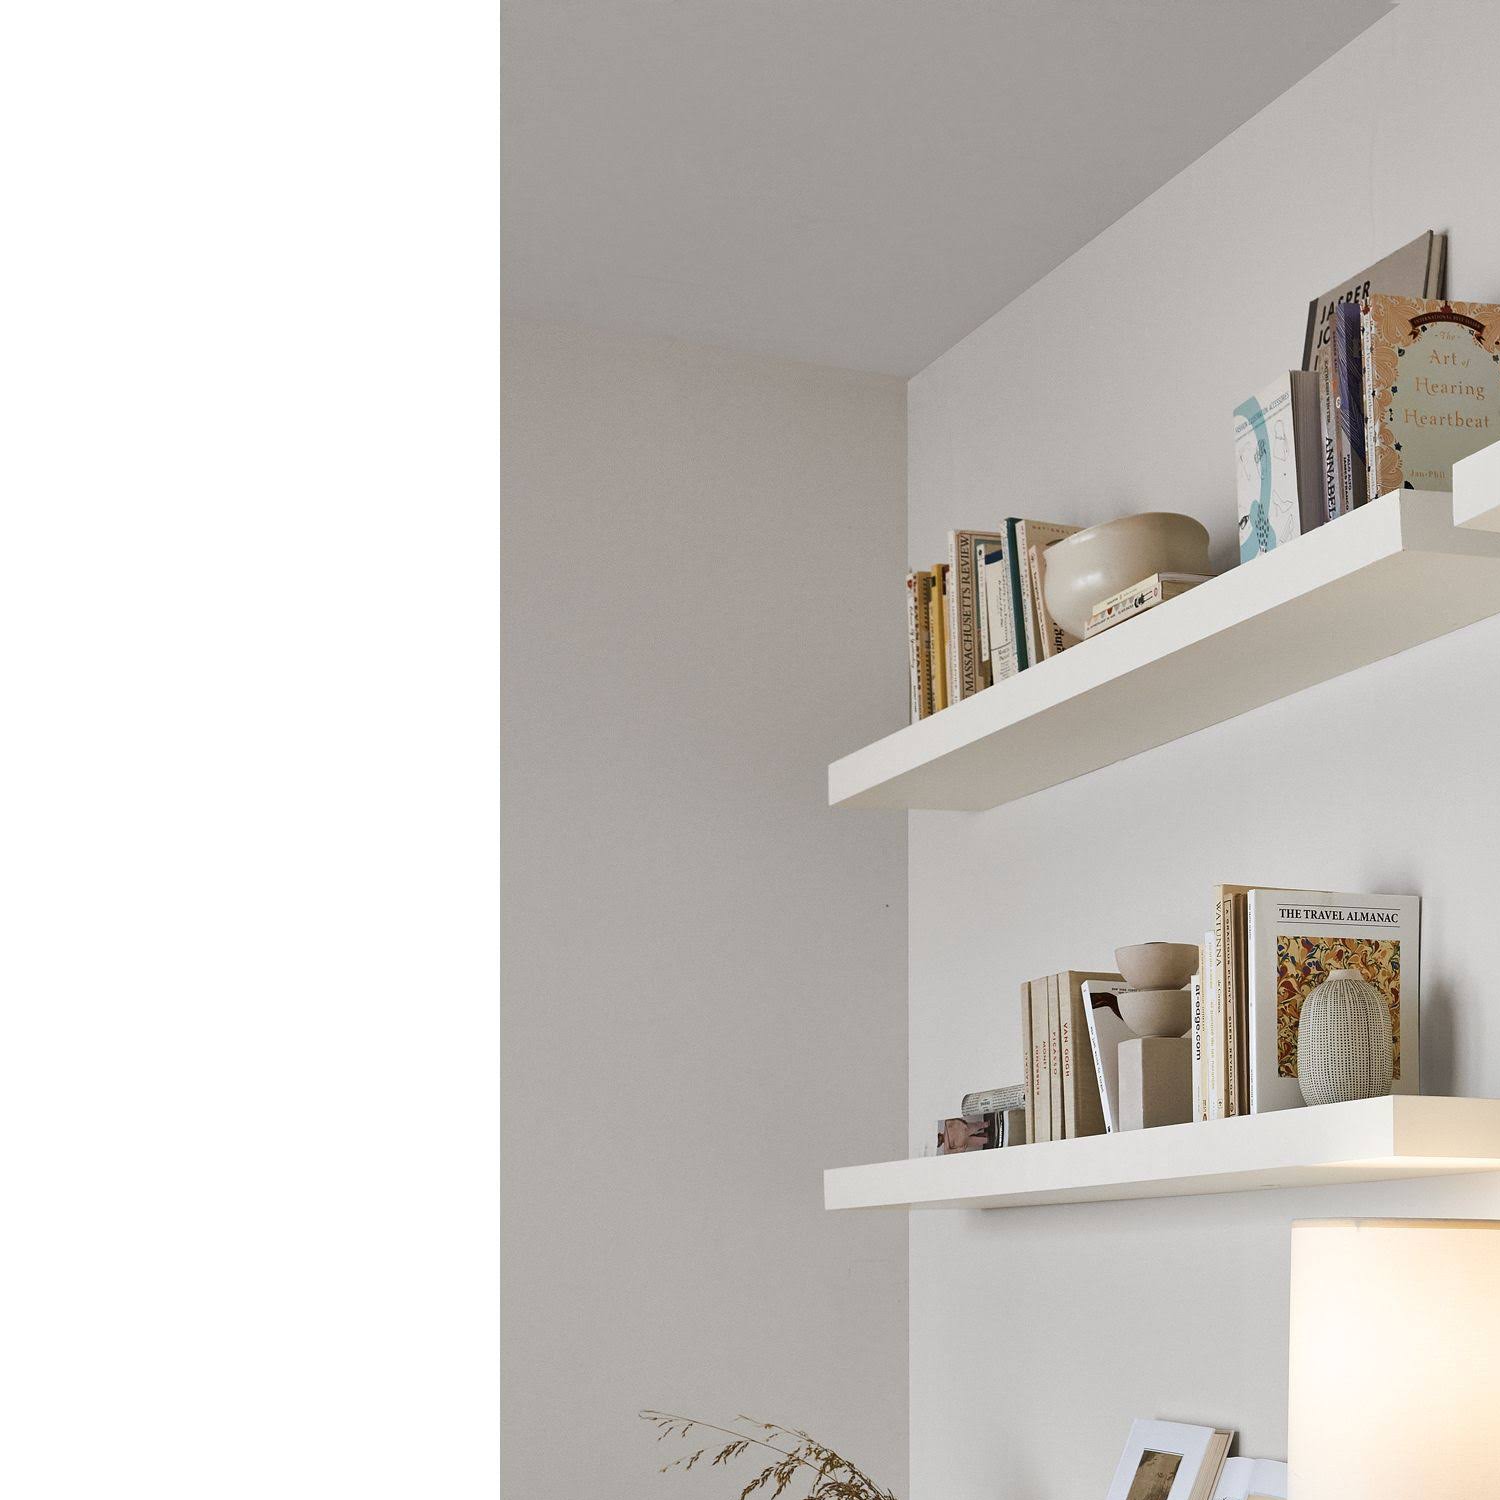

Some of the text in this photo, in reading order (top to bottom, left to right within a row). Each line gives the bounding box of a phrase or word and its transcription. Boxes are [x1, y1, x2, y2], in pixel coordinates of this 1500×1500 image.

[1429, 349, 1471, 369] Art of
[1414, 376, 1486, 401] Hearing
[1403, 408, 1489, 428] Heartbeat
[1325, 436, 1337, 519] ANNABEL
[960, 535, 975, 693] MASSACHUSETTS REVIEW
[1278, 906, 1399, 925] THE TRAVEL ALMANAC
